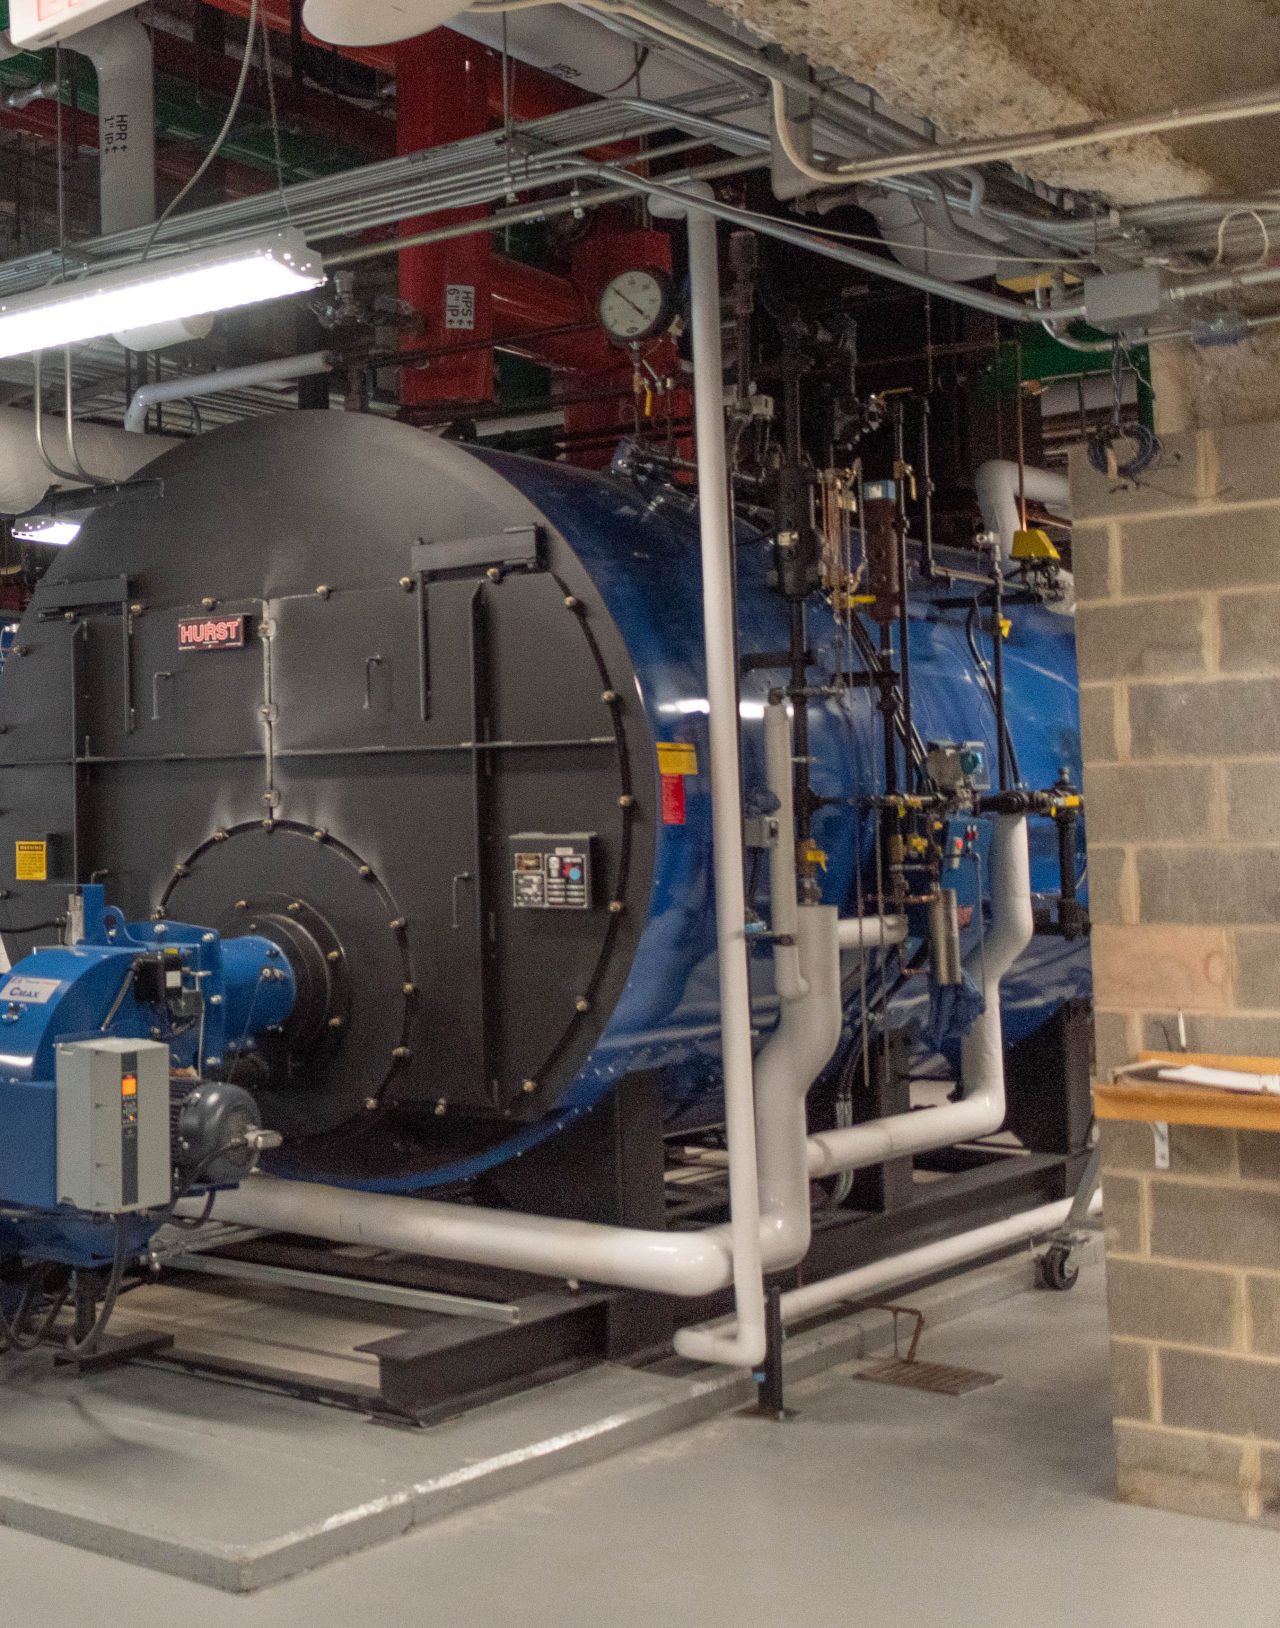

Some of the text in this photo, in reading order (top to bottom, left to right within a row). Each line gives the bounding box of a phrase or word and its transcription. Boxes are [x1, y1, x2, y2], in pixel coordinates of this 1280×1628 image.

[104, 132, 114, 145] IP
[116, 114, 129, 141] HPR
[447, 305, 460, 317] IP
[461, 291, 473, 317] HPS
[180, 621, 239, 643] HURST
